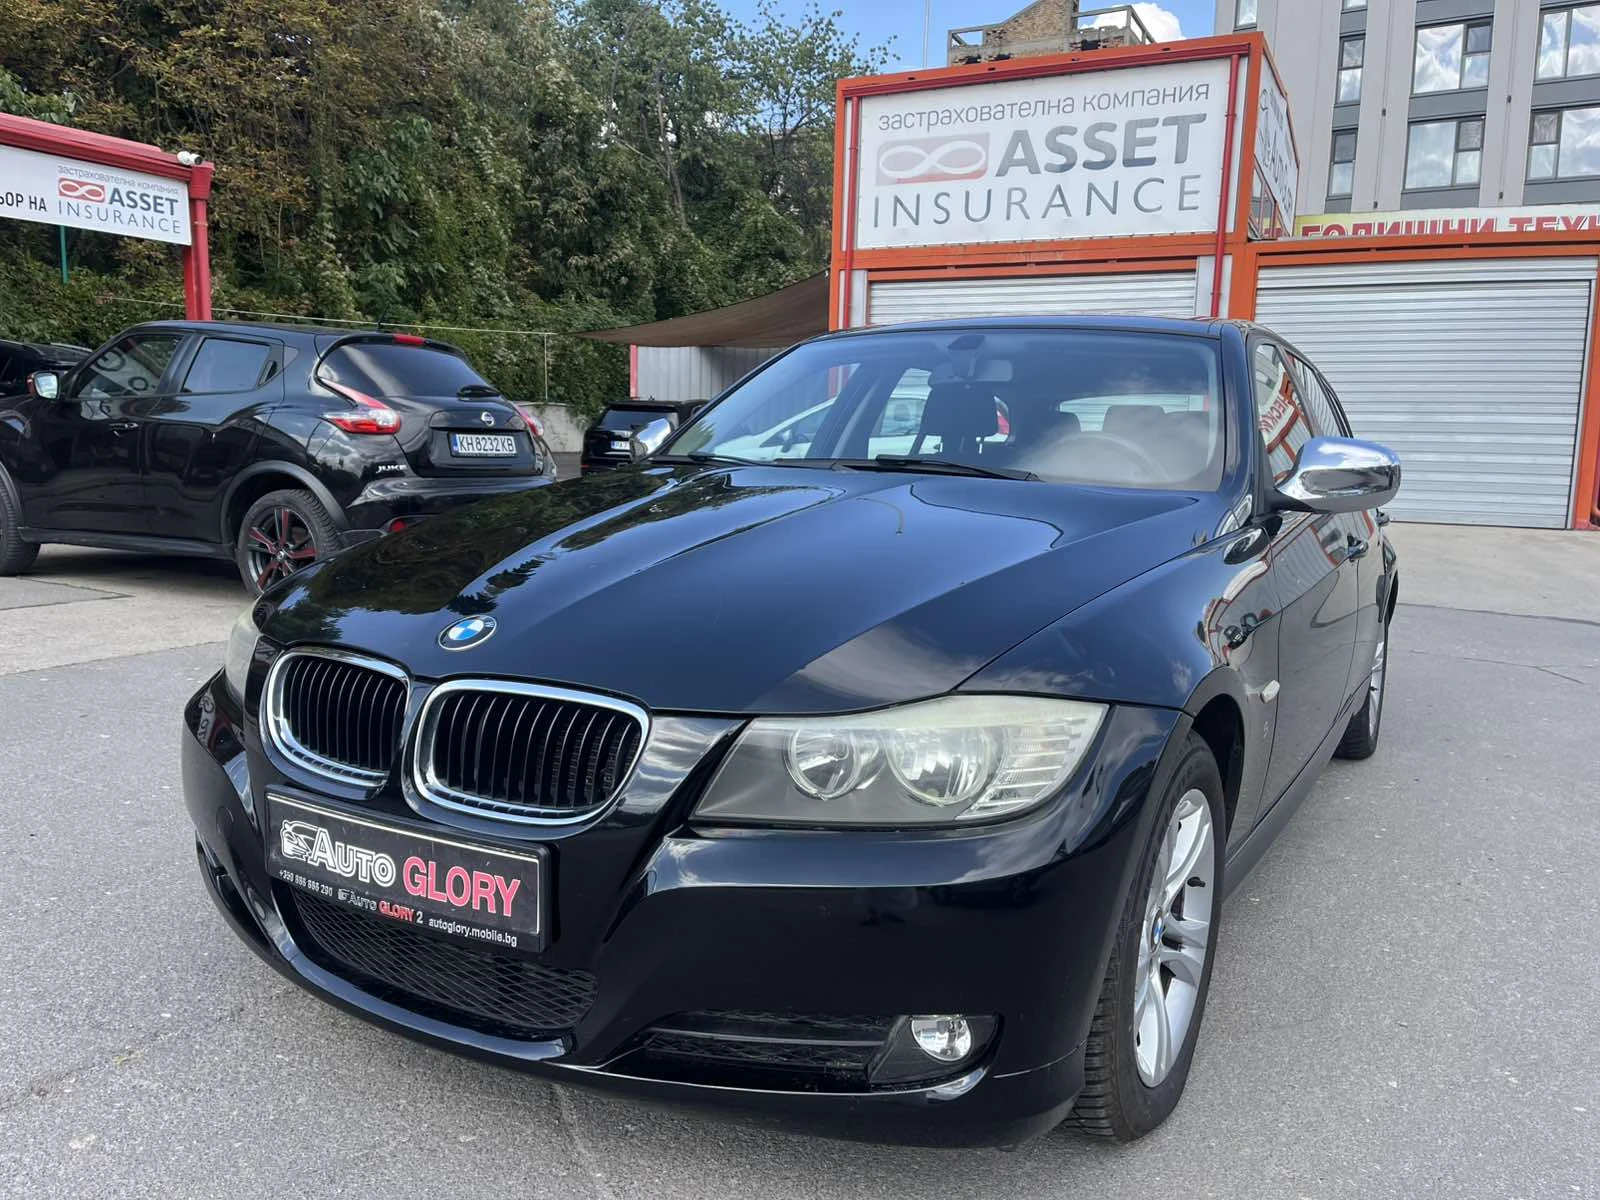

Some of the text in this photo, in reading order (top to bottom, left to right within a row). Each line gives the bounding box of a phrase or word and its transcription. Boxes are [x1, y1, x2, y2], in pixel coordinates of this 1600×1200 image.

[878, 83, 1210, 132] застрахователна компания
[995, 113, 1207, 177] ASSET
[29, 195, 47, 212] НА
[58, 200, 181, 234] INSURANCE
[108, 187, 179, 216] ASSET
[873, 174, 1202, 228] INSURANCE
[402, 856, 521, 917] GLORY
[378, 900, 415, 921] GLORY
[416, 910, 424, 924] 2
[428, 917, 518, 948] autoglory.mobile.bg
